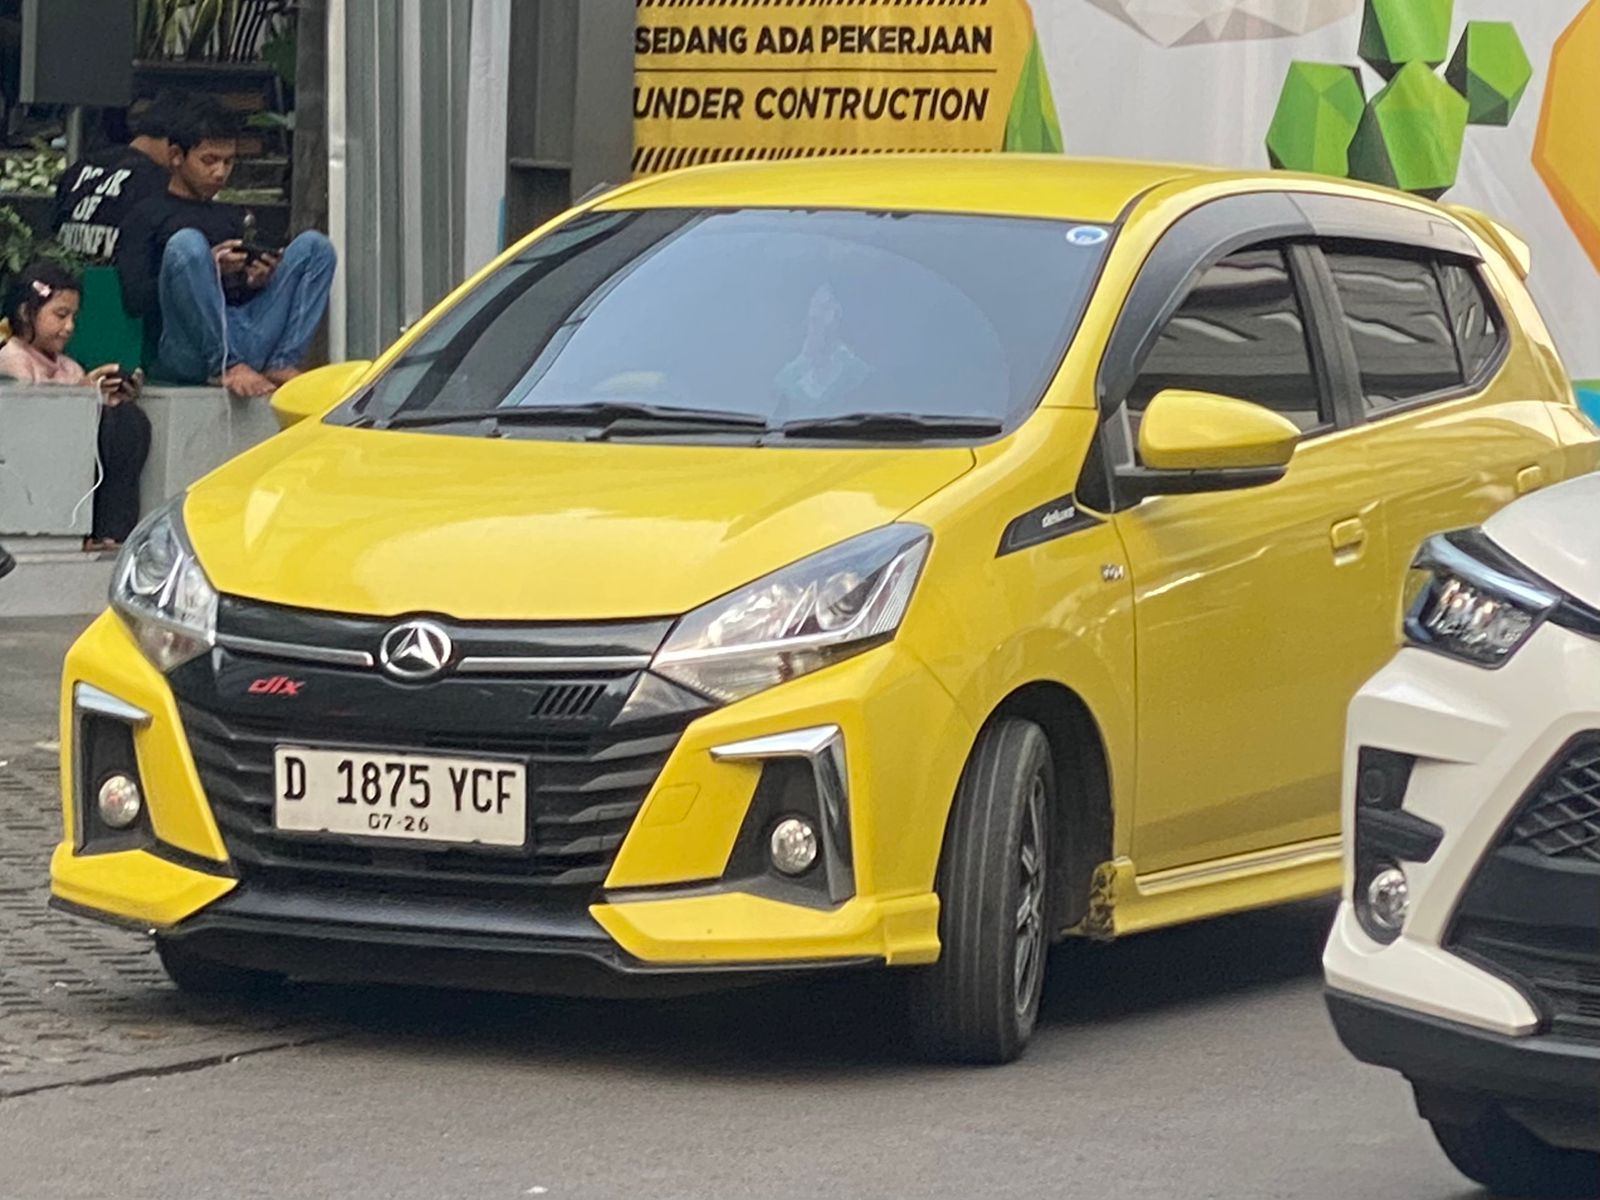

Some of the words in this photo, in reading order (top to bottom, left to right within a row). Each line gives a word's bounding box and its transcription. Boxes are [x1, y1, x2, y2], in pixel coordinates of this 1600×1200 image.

[635, 26, 747, 54] SEDANG
[755, 26, 814, 54] ADA
[821, 26, 992, 54] PEKERJAAN
[633, 87, 743, 119] UNDER
[755, 87, 989, 121] CONTRUCTION
[283, 756, 306, 801] D
[337, 760, 430, 809] 1875
[448, 767, 516, 814] YCF
